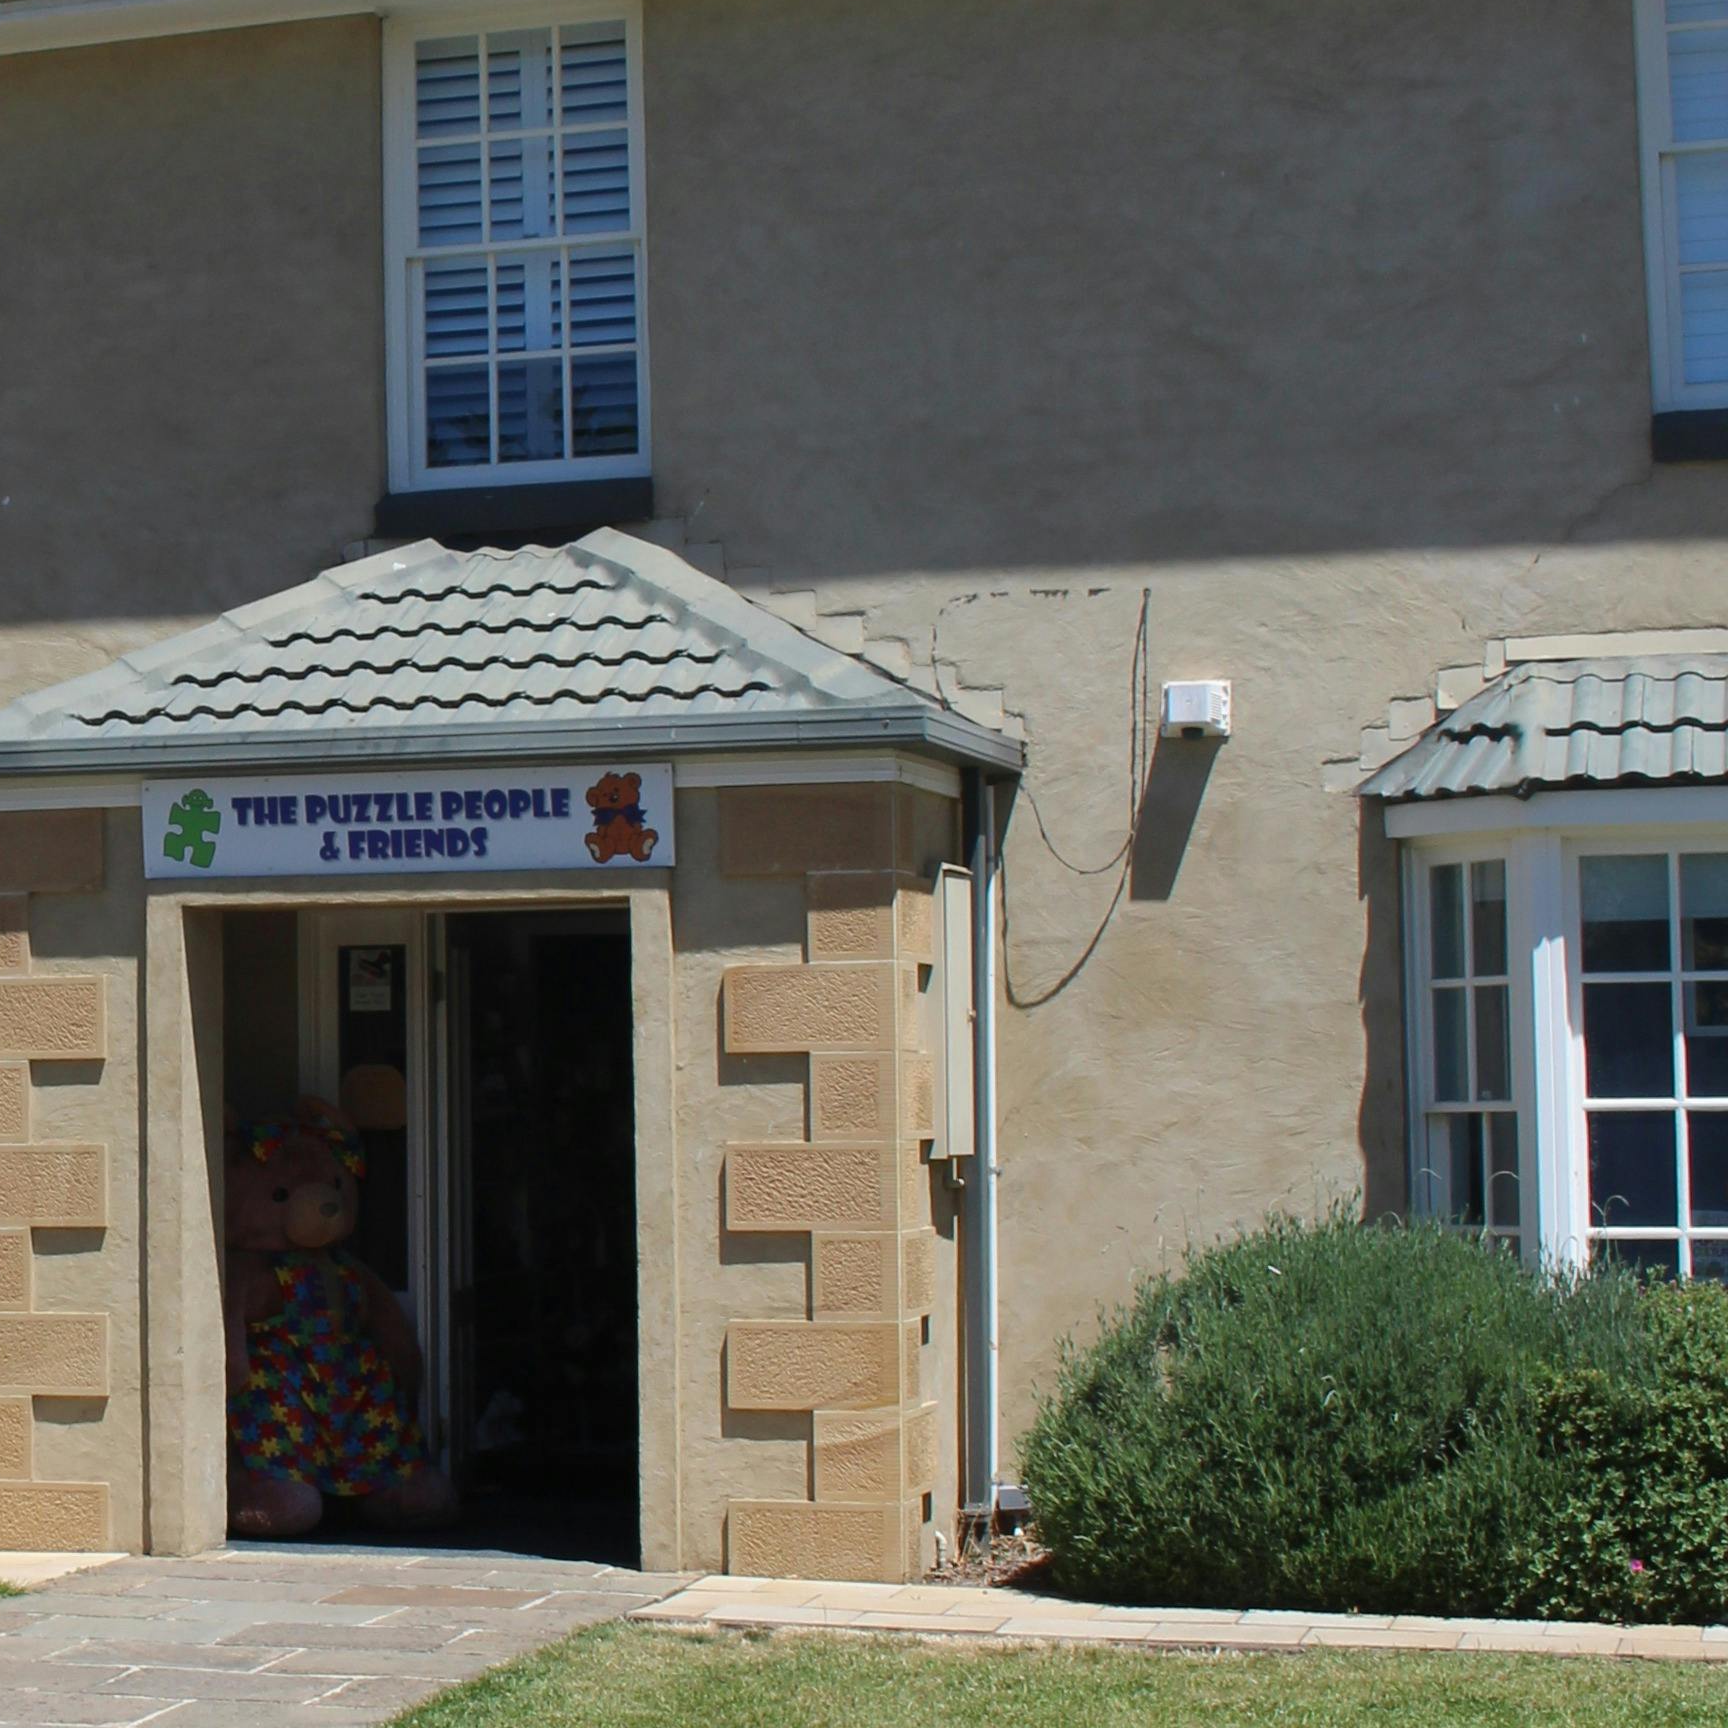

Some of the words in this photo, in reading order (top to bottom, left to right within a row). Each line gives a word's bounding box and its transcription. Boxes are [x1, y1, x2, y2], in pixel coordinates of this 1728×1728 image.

[231, 795, 298, 825] THE
[305, 792, 433, 824] PUZZLE
[440, 788, 570, 821] PEOPLE
[319, 831, 340, 860] &
[348, 827, 488, 860] FRIENDS
